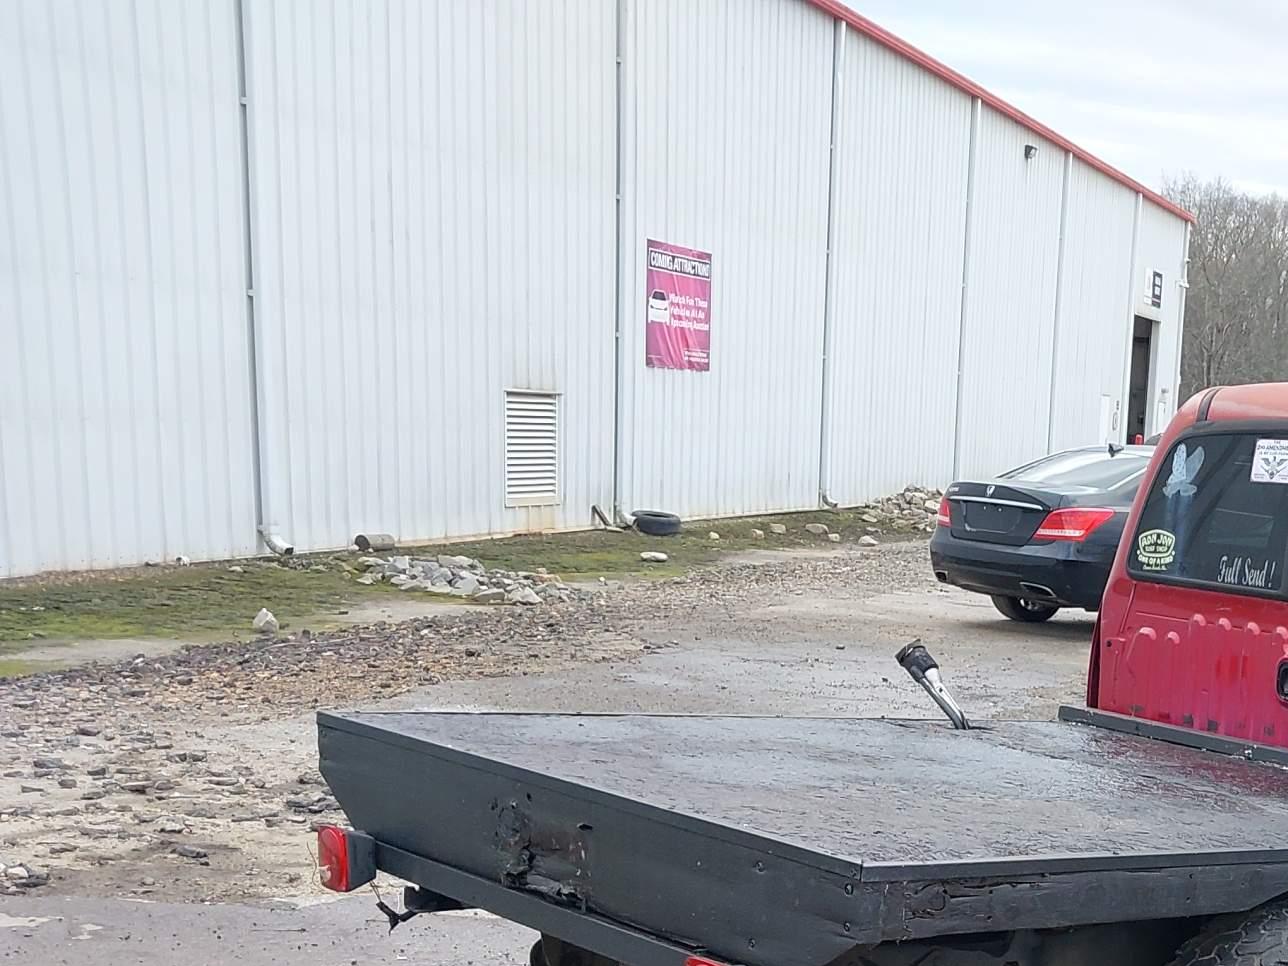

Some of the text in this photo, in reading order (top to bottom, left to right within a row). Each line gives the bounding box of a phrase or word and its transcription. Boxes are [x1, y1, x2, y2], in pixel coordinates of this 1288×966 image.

[1141, 534, 1173, 547] RON JON
[1217, 555, 1242, 584] Full
